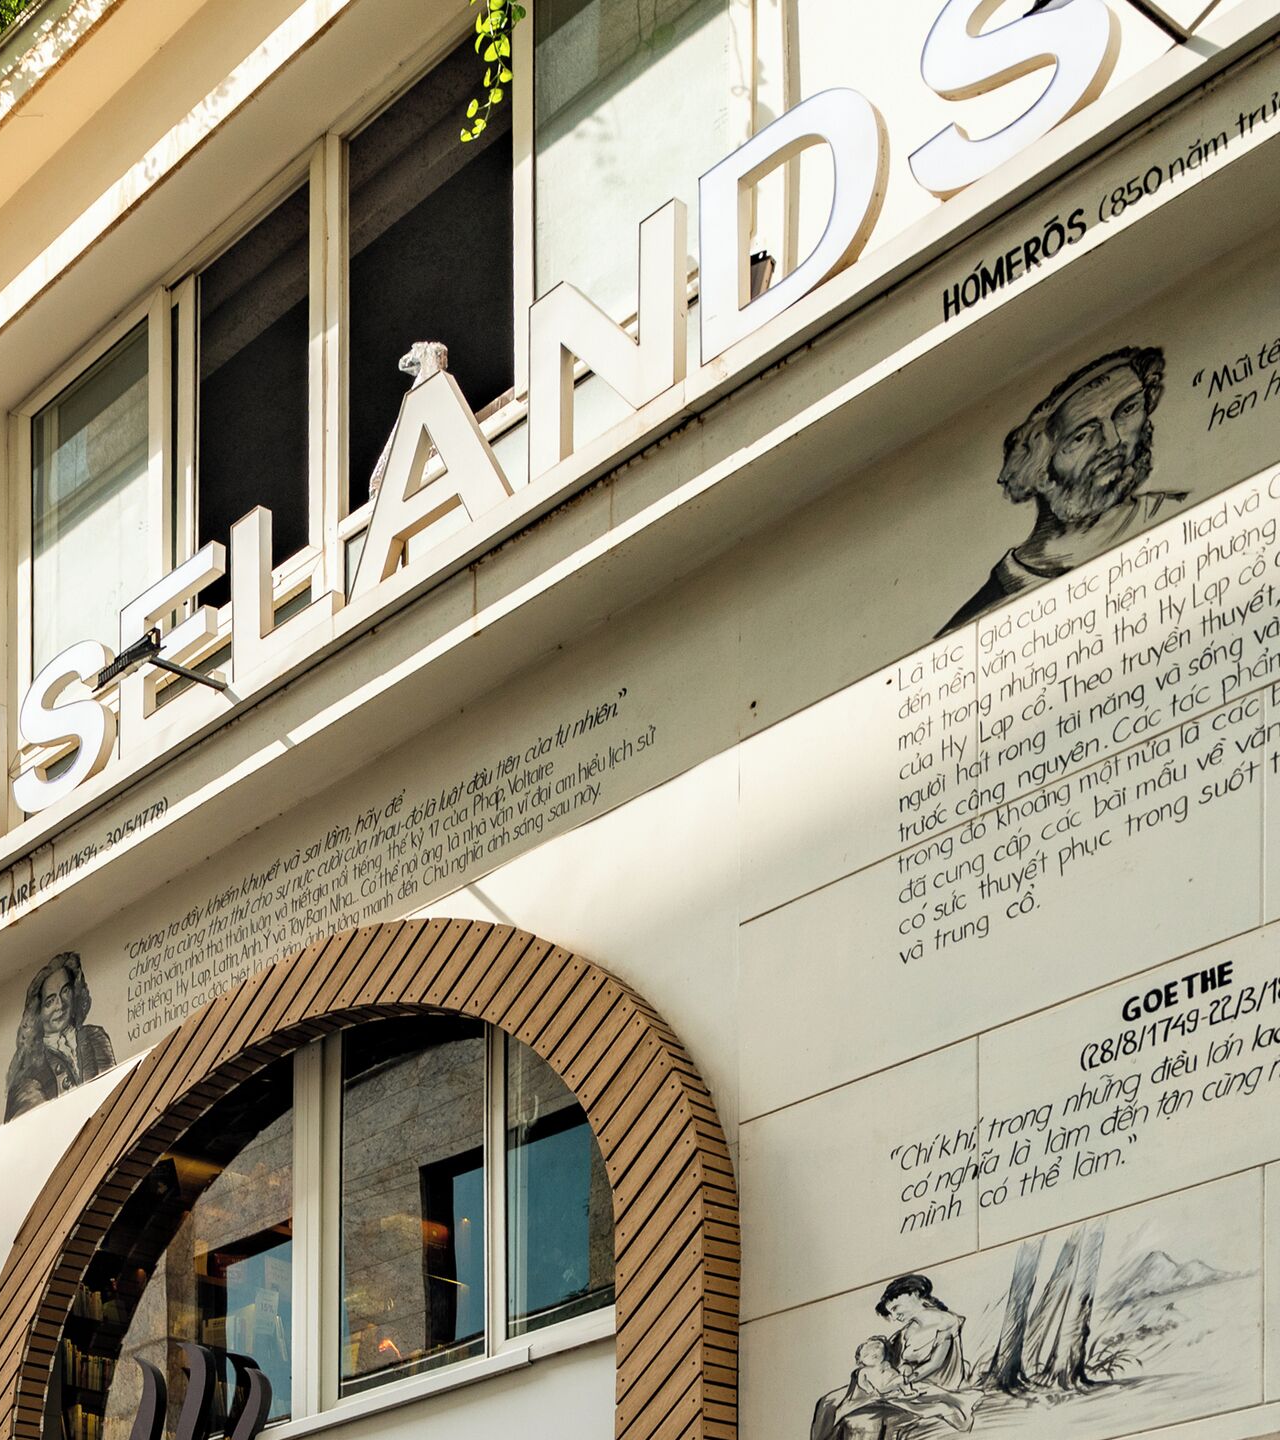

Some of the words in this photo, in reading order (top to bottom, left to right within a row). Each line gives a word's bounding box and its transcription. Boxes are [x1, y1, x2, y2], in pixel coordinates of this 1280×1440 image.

[1169, 131, 1228, 184] năm
[898, 683, 931, 719] đến
[939, 666, 975, 700] nền
[981, 646, 1016, 679] văn
[1022, 607, 1096, 658] chương
[1106, 584, 1146, 618] hiện
[1154, 560, 1186, 592] đại
[898, 718, 933, 750] một
[942, 692, 992, 729] trong
[1001, 660, 1058, 701] những
[1066, 634, 1104, 669] nhà
[1114, 612, 1148, 645] thơ
[1160, 594, 1186, 629] Hy
[1192, 576, 1229, 610] Lạp
[1239, 546, 1266, 586] cổ
[932, 642, 964, 674] tác
[980, 615, 1012, 652] giả
[1017, 598, 1057, 629] của
[1068, 573, 1099, 603] tác
[1109, 538, 1169, 587] phẩm
[1234, 489, 1259, 517] và
[899, 752, 933, 780] của
[942, 734, 967, 762] Hy
[979, 714, 1014, 744] Lạp
[1058, 665, 1112, 702] Theo
[1122, 626, 1191, 673] truyền
[899, 774, 946, 813] người
[957, 749, 991, 782] hát
[998, 729, 1046, 768] rong
[1056, 709, 1081, 738] tài
[1089, 684, 1146, 723] năng
[1156, 664, 1181, 691] và
[1189, 638, 1243, 677] sống
[899, 808, 948, 842] trước
[956, 782, 1006, 816] công
[1112, 706, 1161, 743] Các
[1172, 684, 1211, 717] tác
[899, 837, 954, 874] trong
[960, 819, 986, 845] đó
[997, 780, 1071, 830] khoảng
[1080, 756, 1119, 789] một
[1128, 734, 1171, 770] nửa
[1181, 722, 1200, 748] là
[1212, 695, 1260, 731] các
[899, 878, 926, 903] đã
[933, 853, 985, 889] cung
[994, 828, 1031, 862] cấp
[1041, 808, 1082, 841] các
[1094, 787, 1126, 818] bài
[1136, 759, 1187, 798] mẫu
[1197, 737, 1226, 771] về
[899, 902, 926, 934] có
[933, 890, 967, 921] sức
[979, 850, 1048, 899] thuyết
[1059, 829, 1112, 876] phục
[1125, 795, 1189, 837] trong
[1198, 761, 1261, 804] suốt
[899, 939, 924, 964] và
[935, 913, 989, 950] trung
[1122, 960, 1234, 1022] GOETHE
[901, 1170, 930, 1202] có
[934, 1151, 1000, 1194] nghĩa
[1009, 1138, 1031, 1168] là
[1044, 1121, 1089, 1156] làm
[1100, 1099, 1149, 1137] đến
[1156, 1088, 1192, 1121] tận
[1202, 1061, 1264, 1102] cùng
[989, 1103, 1052, 1142] trong
[1062, 1073, 1141, 1116] những
[1151, 1049, 1197, 1084] điều
[1206, 1031, 1243, 1068] lớn
[901, 1193, 962, 1234] mình
[980, 1176, 1008, 1209] có
[1019, 1156, 1061, 1198] thể
